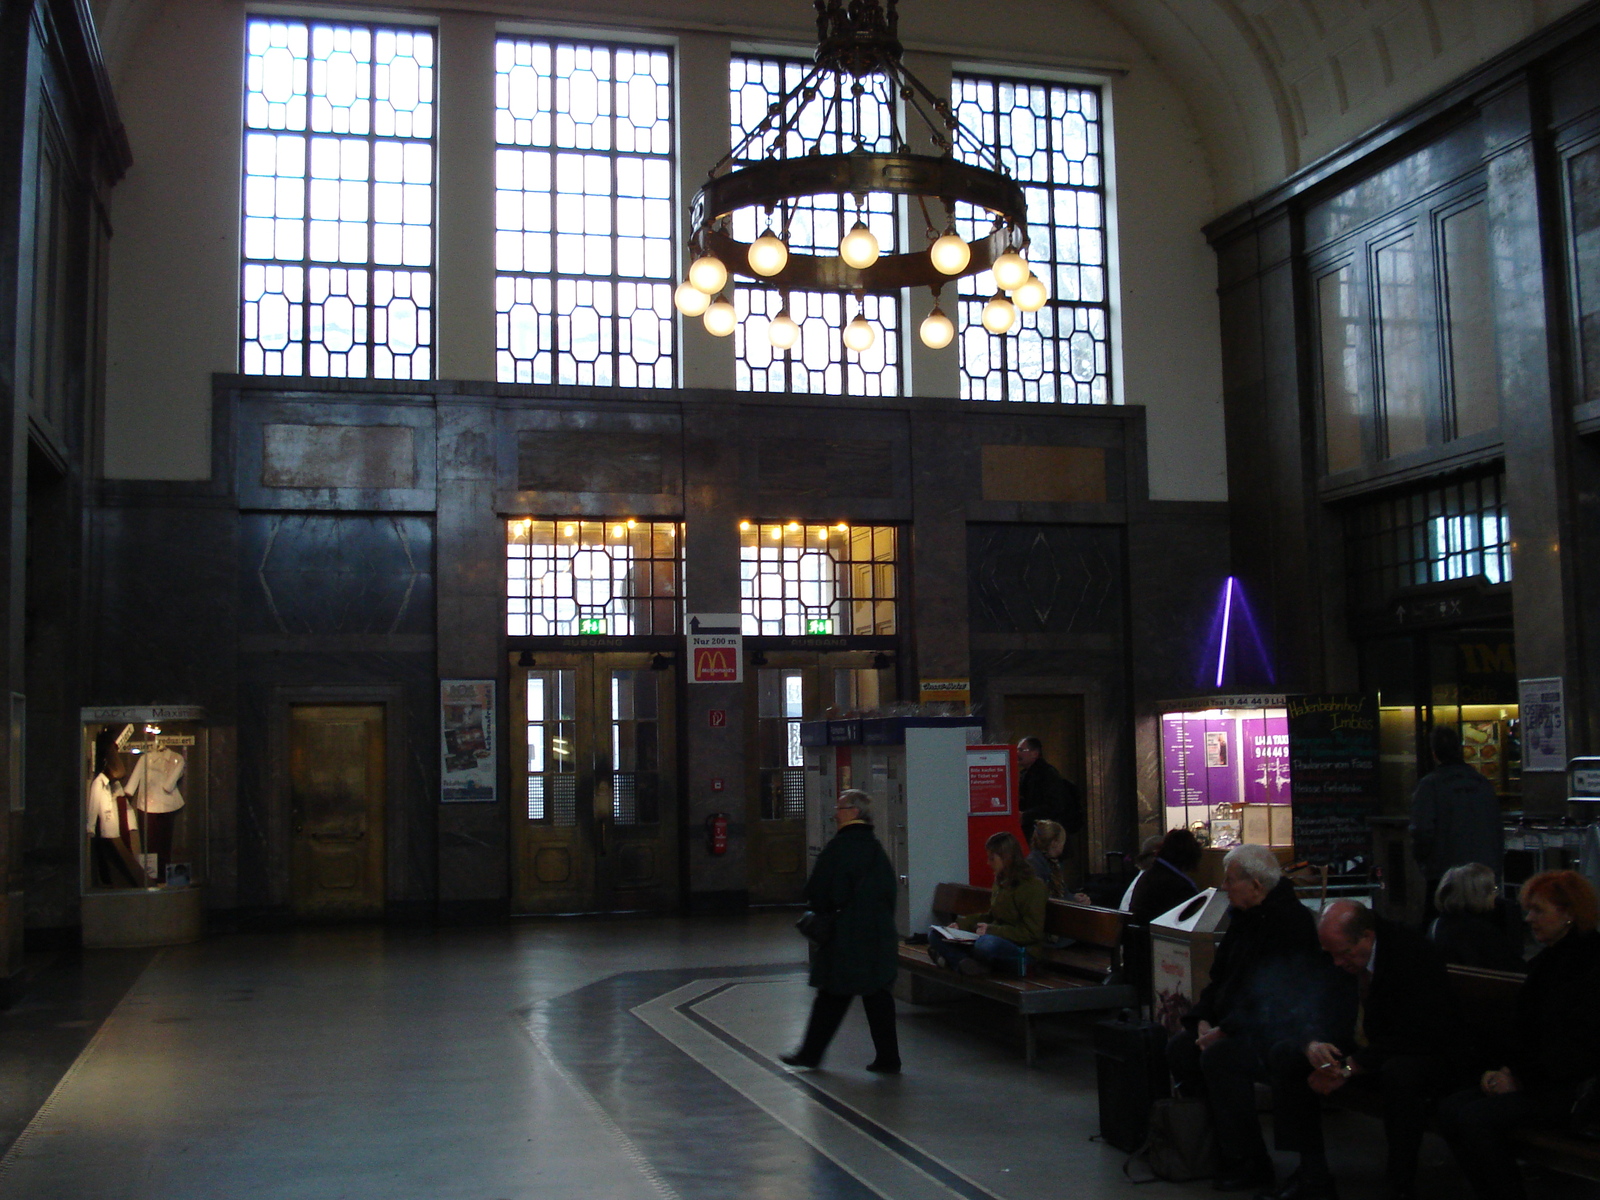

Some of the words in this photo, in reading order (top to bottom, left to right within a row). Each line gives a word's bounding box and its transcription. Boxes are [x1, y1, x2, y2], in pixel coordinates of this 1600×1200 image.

[562, 638, 623, 647] AUSGANG
[790, 638, 847, 646] AUSGANG
[1288, 696, 1367, 719] Hafenbahnhof
[1329, 712, 1374, 731] Imbiss
[119, 743, 154, 752] eduziert
[1255, 747, 1261, 758] 9
[1272, 746, 1283, 758] 44
[1283, 746, 1289, 758] 9
